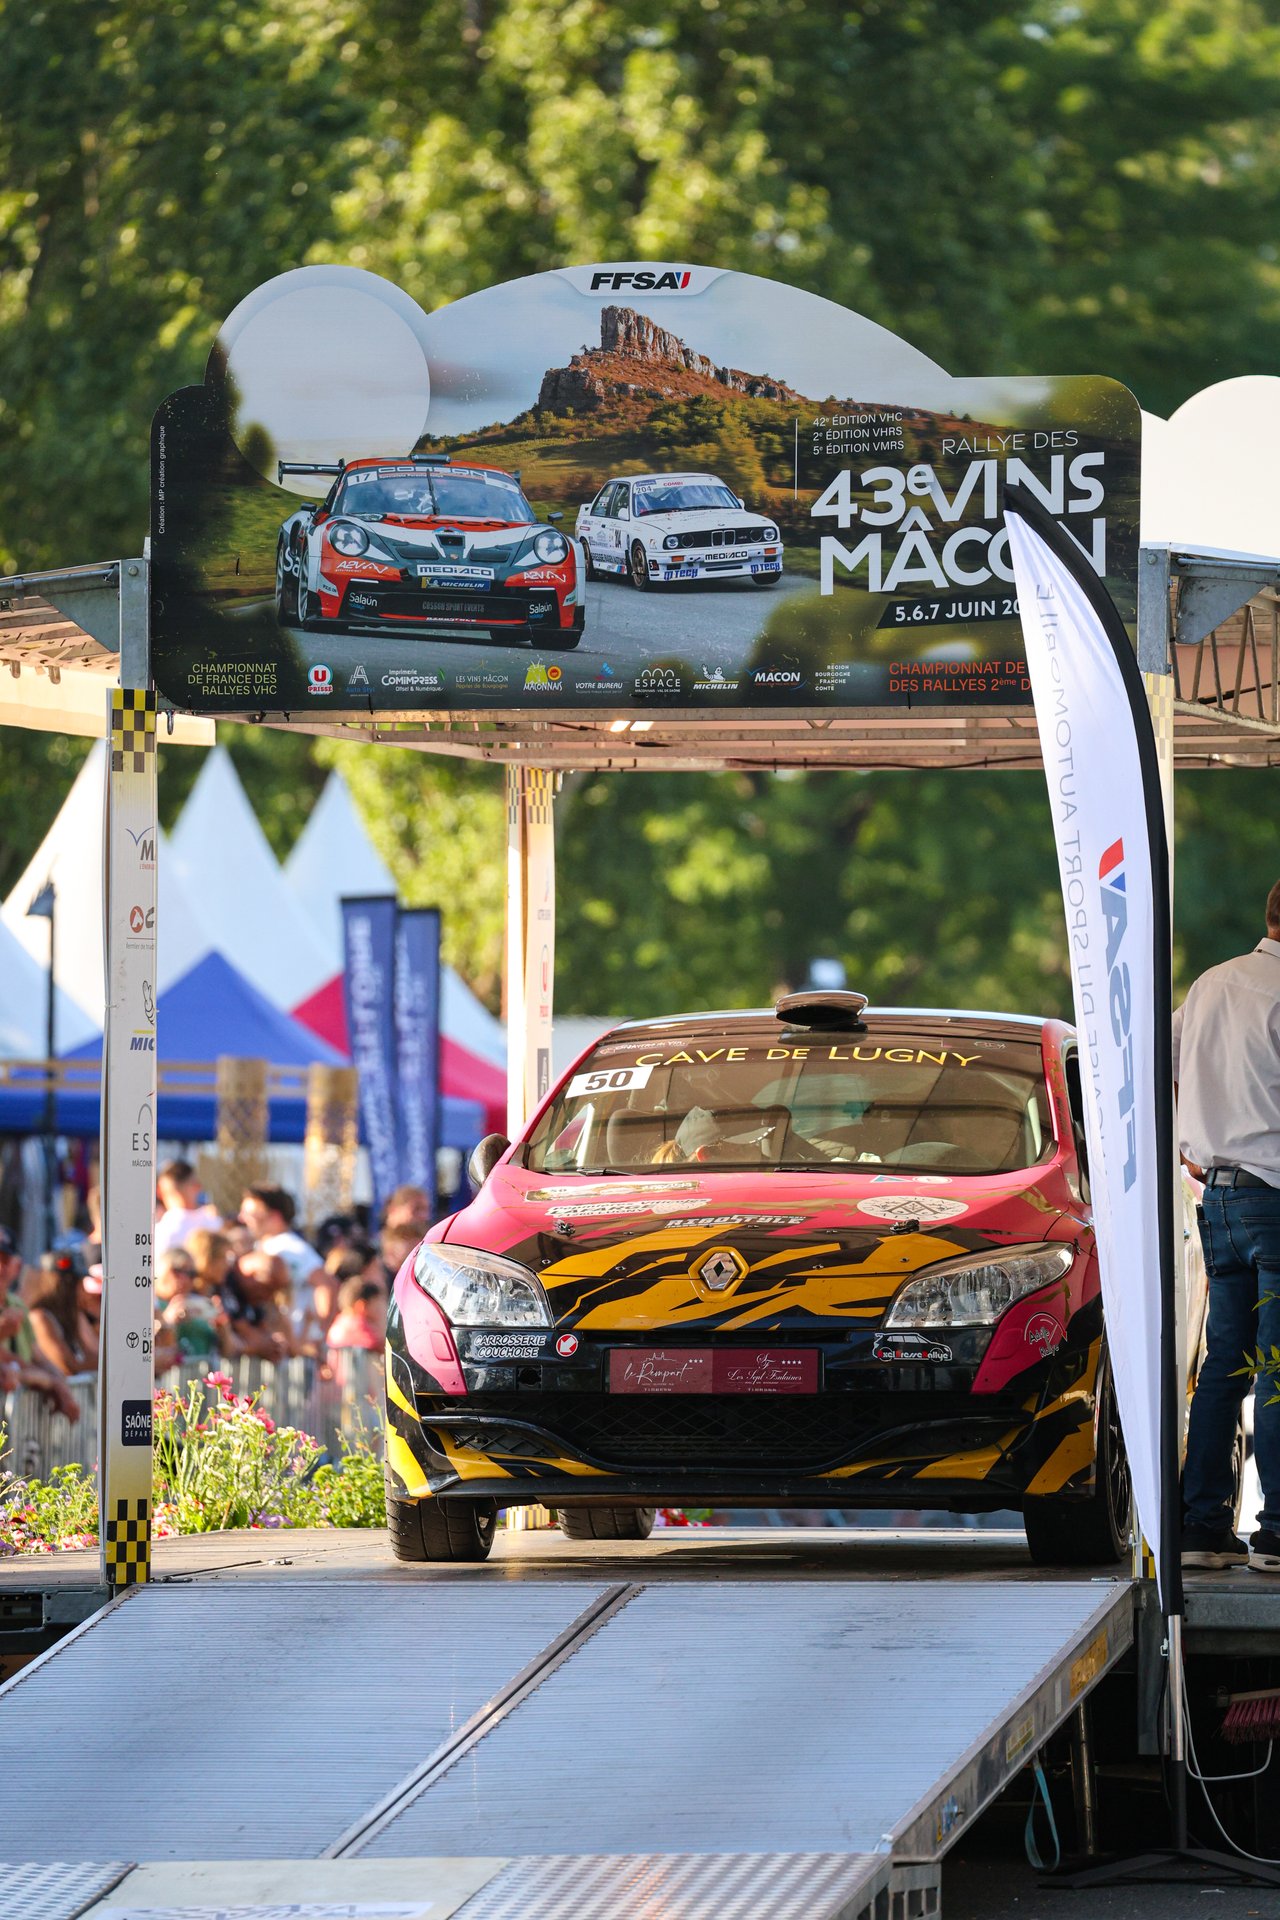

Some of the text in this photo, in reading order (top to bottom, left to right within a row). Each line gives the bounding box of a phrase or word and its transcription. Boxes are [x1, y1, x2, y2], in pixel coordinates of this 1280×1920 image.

[590, 271, 680, 290] FFSA
[832, 413, 876, 426] ÉDITION
[878, 411, 903, 423] VHC
[826, 427, 870, 441] ÉDITION
[872, 426, 903, 437] VHRS
[158, 425, 167, 459] graphique
[826, 441, 870, 455] ÉDITION
[872, 440, 904, 451] VMRS
[942, 430, 1078, 455] RALLYE DES
[895, 604, 940, 622] 5.6.7
[945, 601, 995, 618] JUIN
[192, 663, 277, 674] CHAMPIONNAT
[889, 661, 1025, 675] CHAMPIONNAT DE
[187, 674, 277, 684] DE FRANCE DES
[634, 678, 681, 688] ESPACE
[889, 679, 919, 692] DES
[923, 678, 987, 691] RALLYES
[202, 685, 277, 695] RALLYES VHC
[635, 1046, 983, 1067] CAVE DE LUGNY
[584, 1070, 635, 1091] 50
[474, 1335, 547, 1347] CARROSSERIE
[478, 1347, 539, 1358] COUCHOISE
